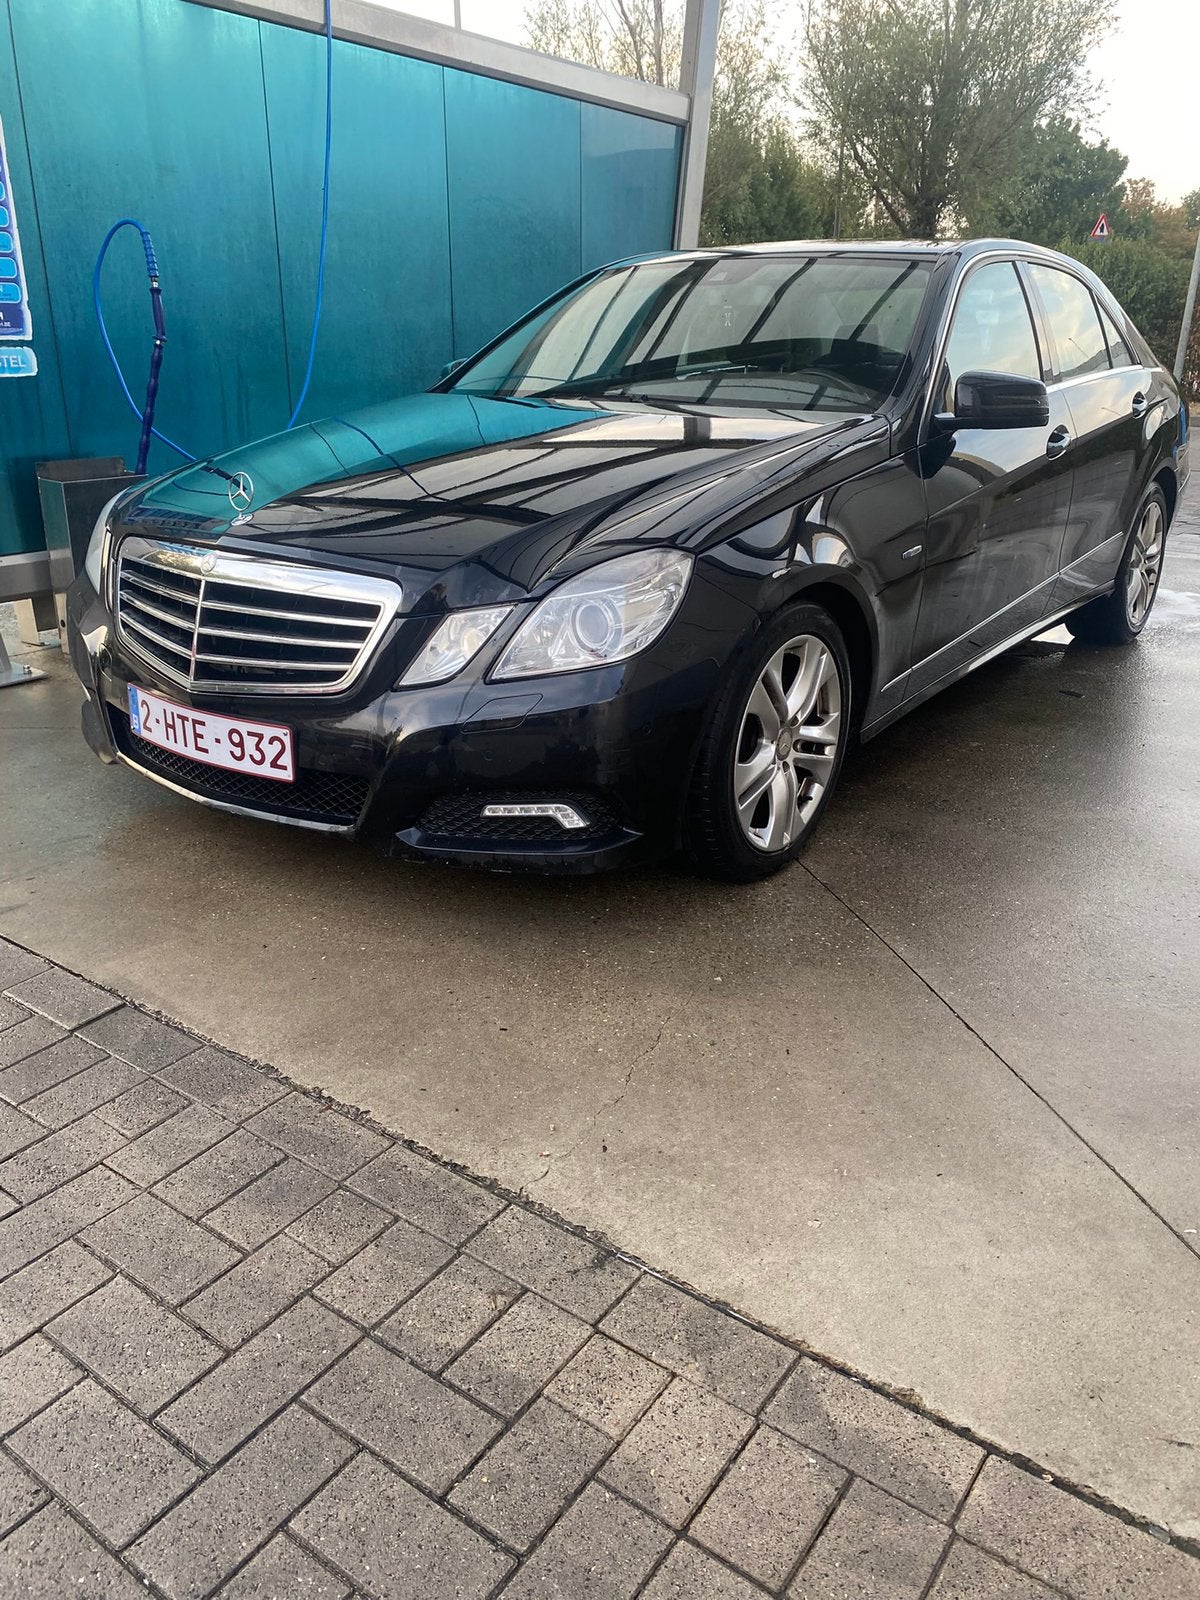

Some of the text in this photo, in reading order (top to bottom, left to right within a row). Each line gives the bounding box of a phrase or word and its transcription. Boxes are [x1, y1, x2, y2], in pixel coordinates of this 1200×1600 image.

[0, 355, 26, 368] TEL
[132, 713, 139, 729] B
[140, 700, 289, 771] 2-HTE-932
